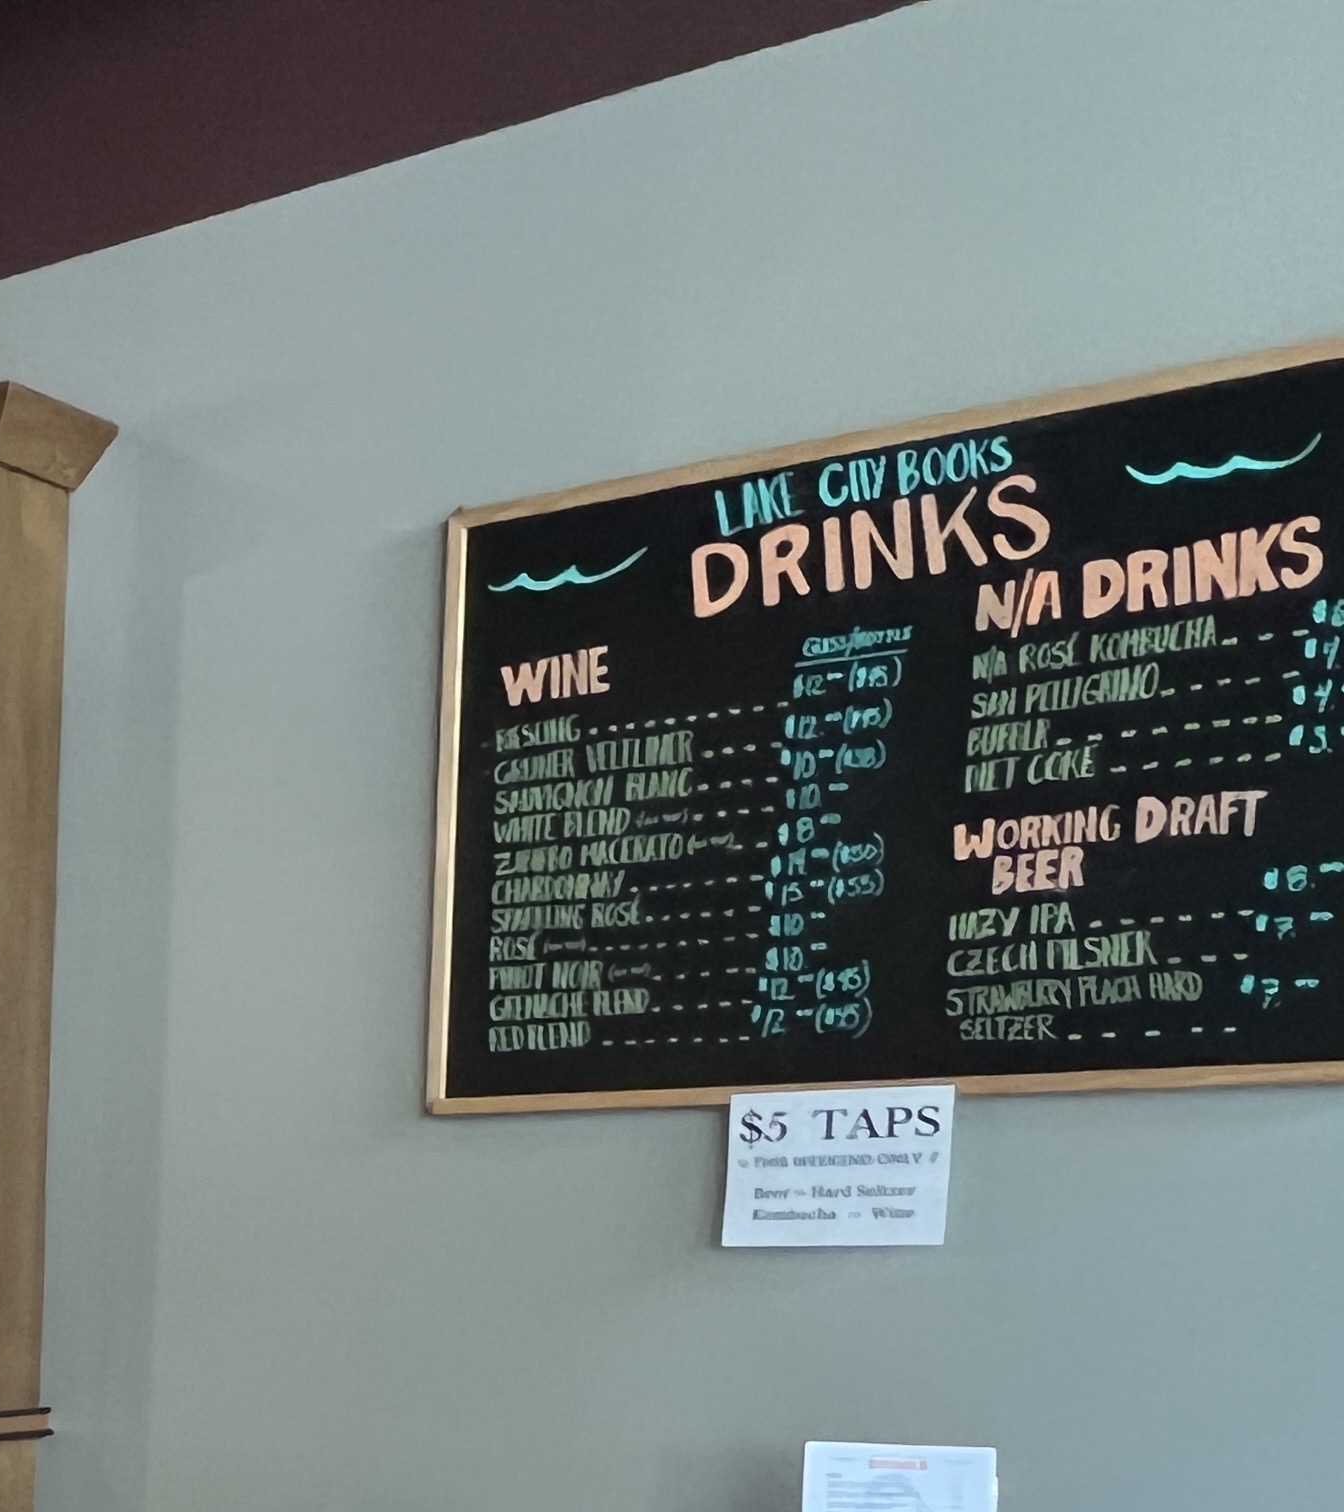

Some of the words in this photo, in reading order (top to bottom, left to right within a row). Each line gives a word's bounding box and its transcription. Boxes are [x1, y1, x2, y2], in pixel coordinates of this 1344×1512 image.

[714, 471, 805, 537] LAKE
[818, 455, 887, 507] CITY
[897, 435, 1013, 496] BOOKS
[691, 474, 1051, 619] DRINKS
[975, 567, 1062, 638] N/A
[1083, 515, 1324, 619] DRINKS
[1090, 615, 1217, 663] KOMBUCHA
[500, 645, 610, 706] WINE
[971, 687, 1017, 719] SAN
[496, 713, 581, 752] RIESLING
[625, 767, 693, 801] BLANC
[965, 756, 1021, 793] DIET
[1027, 743, 1099, 785] COKE
[493, 812, 559, 843] WHITE
[564, 807, 631, 838] BLEND
[953, 804, 1121, 861] WORKING
[1135, 790, 1269, 844] DRAFT
[491, 869, 625, 905] CHARDONNAY
[992, 846, 1084, 895] BEER
[949, 906, 1020, 941] HAZY
[1030, 901, 1076, 935] IPA
[946, 940, 1037, 977] CZECH
[1047, 930, 1158, 970] PILSNER
[489, 962, 547, 990] PINOT
[552, 960, 604, 990] NOIR
[1078, 974, 1141, 1007] PEACH
[1148, 970, 1203, 1001] HARD
[593, 988, 649, 1016] BLEND
[489, 1025, 524, 1052] RED
[527, 1021, 591, 1050] BLEND
[960, 1014, 1059, 1041] SELTZER
[739, 1107, 788, 1149] $5
[811, 1105, 940, 1140] TAPS
[812, 1185, 852, 1198] Hard
[856, 1185, 916, 1198] Seltzer
